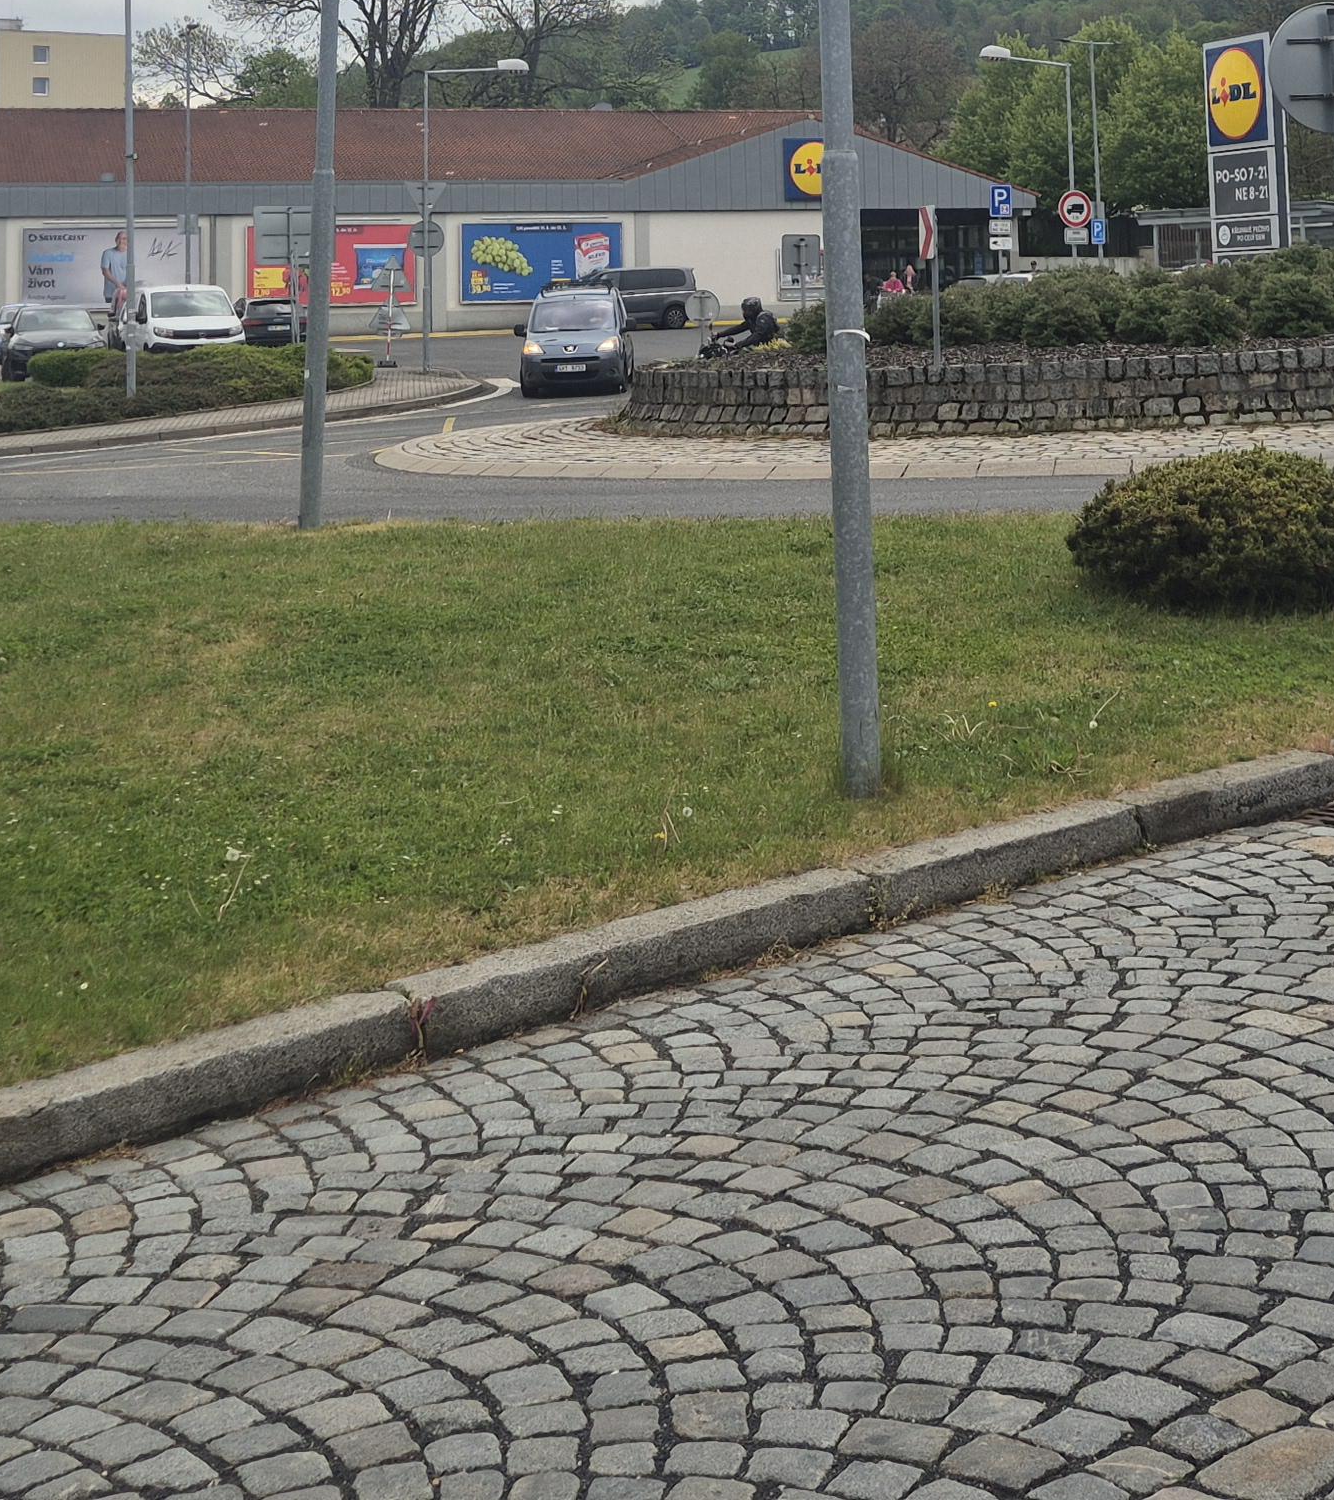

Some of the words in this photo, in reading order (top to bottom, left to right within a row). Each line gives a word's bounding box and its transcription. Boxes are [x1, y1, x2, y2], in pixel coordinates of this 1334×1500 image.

[994, 188, 1007, 208] P
[1235, 187, 1248, 201] NE
[1093, 222, 1102, 237] P
[28, 265, 54, 276] Vám
[27, 277, 56, 289] život
